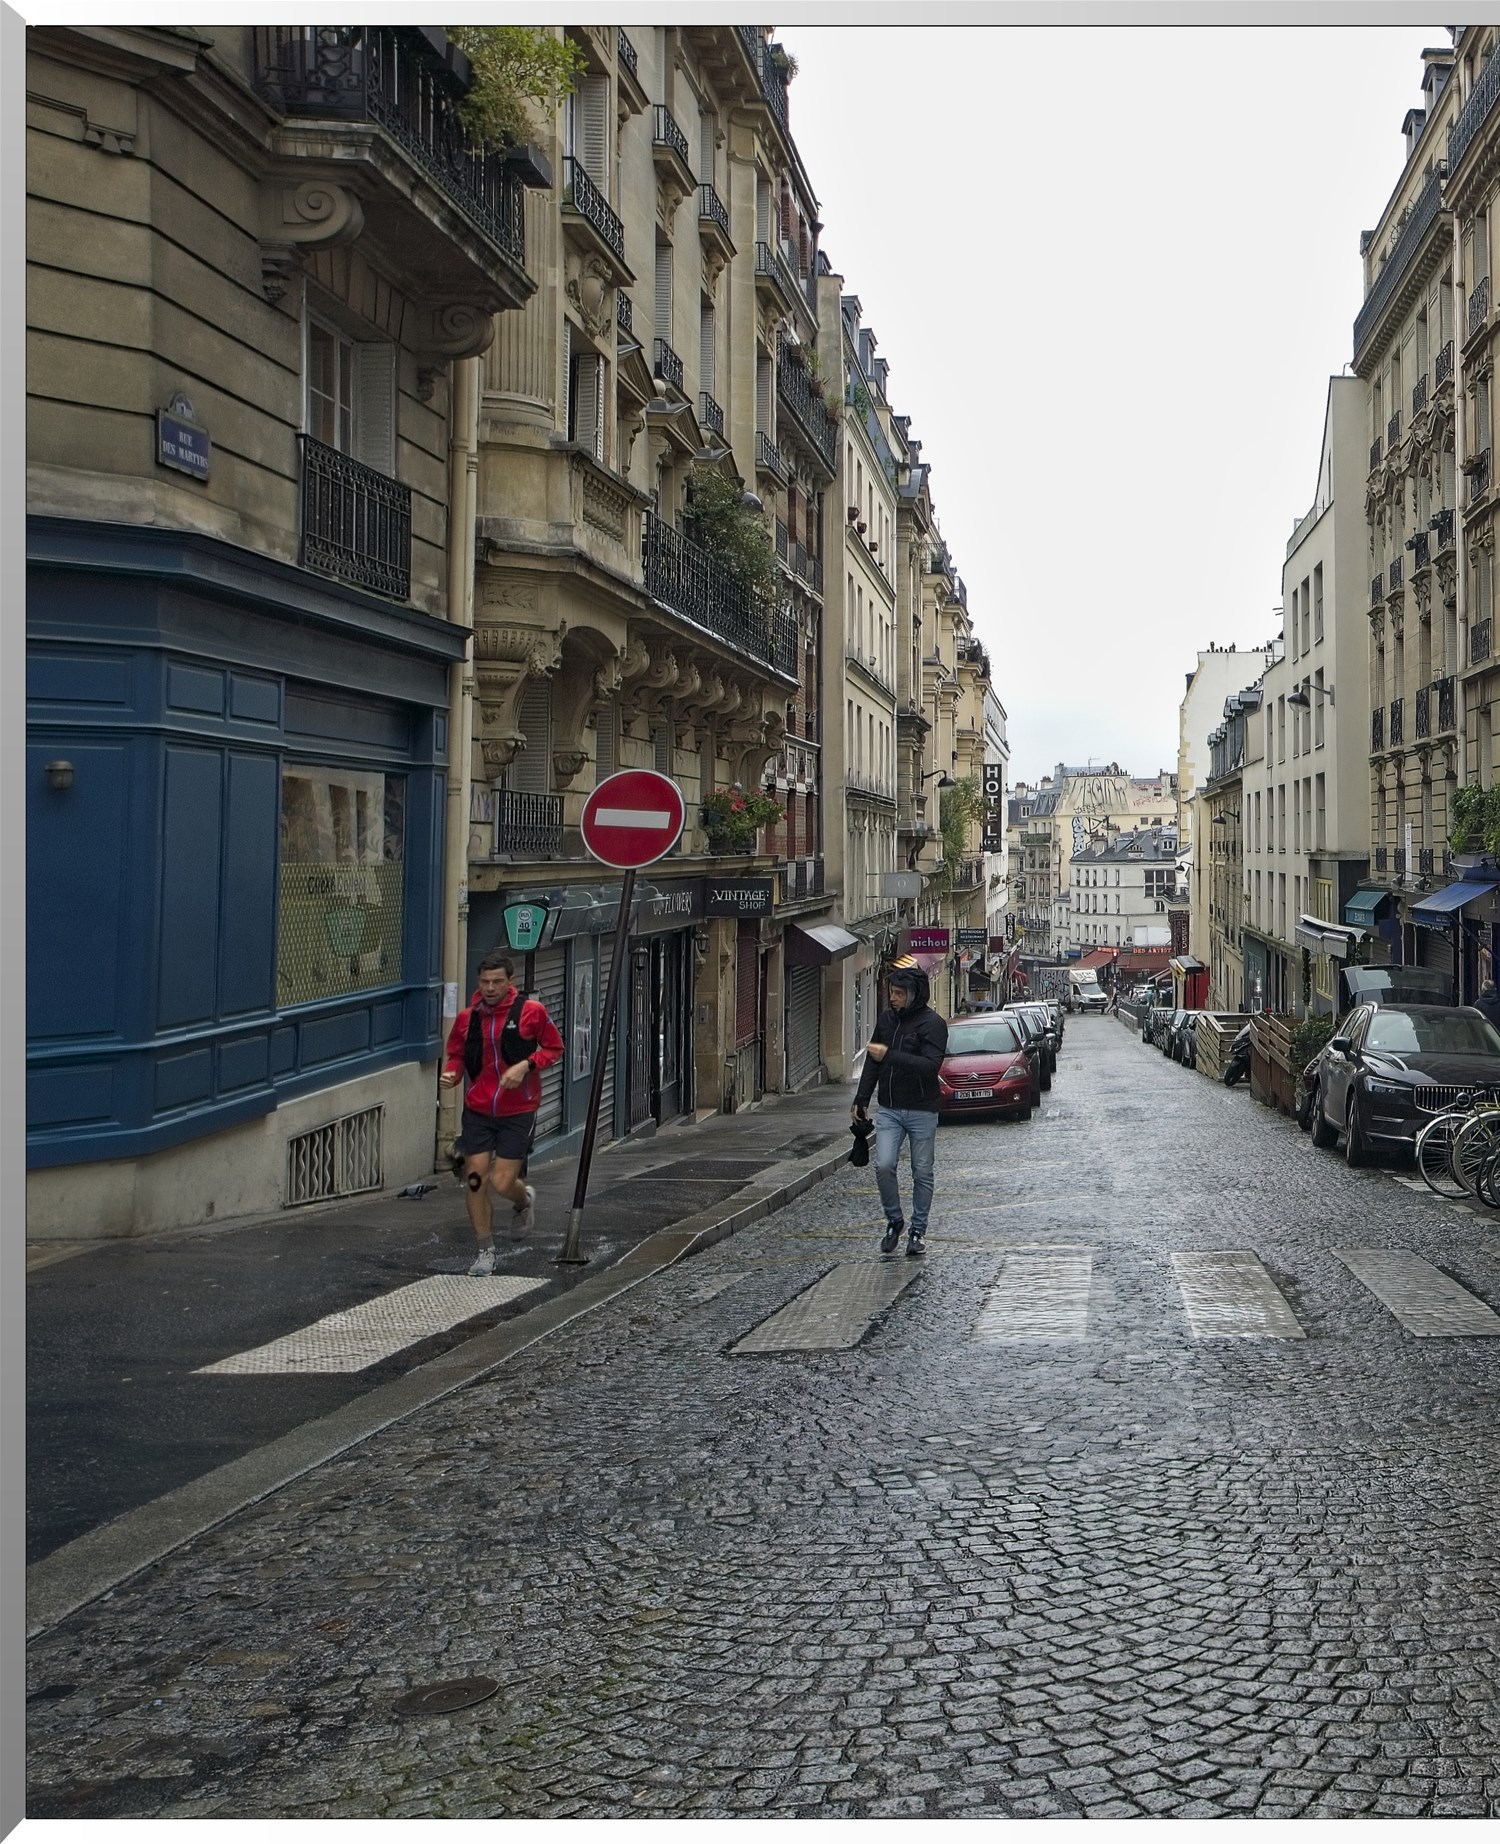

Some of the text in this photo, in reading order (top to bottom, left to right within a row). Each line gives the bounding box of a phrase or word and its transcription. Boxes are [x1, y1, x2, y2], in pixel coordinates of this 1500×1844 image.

[179, 431, 193, 447] RUE
[162, 440, 208, 468] DES MARTYRS
[985, 765, 999, 837] HOTEL
[712, 889, 766, 902] VINTAGE
[738, 901, 766, 910] SHOP
[519, 922, 530, 930] 40
